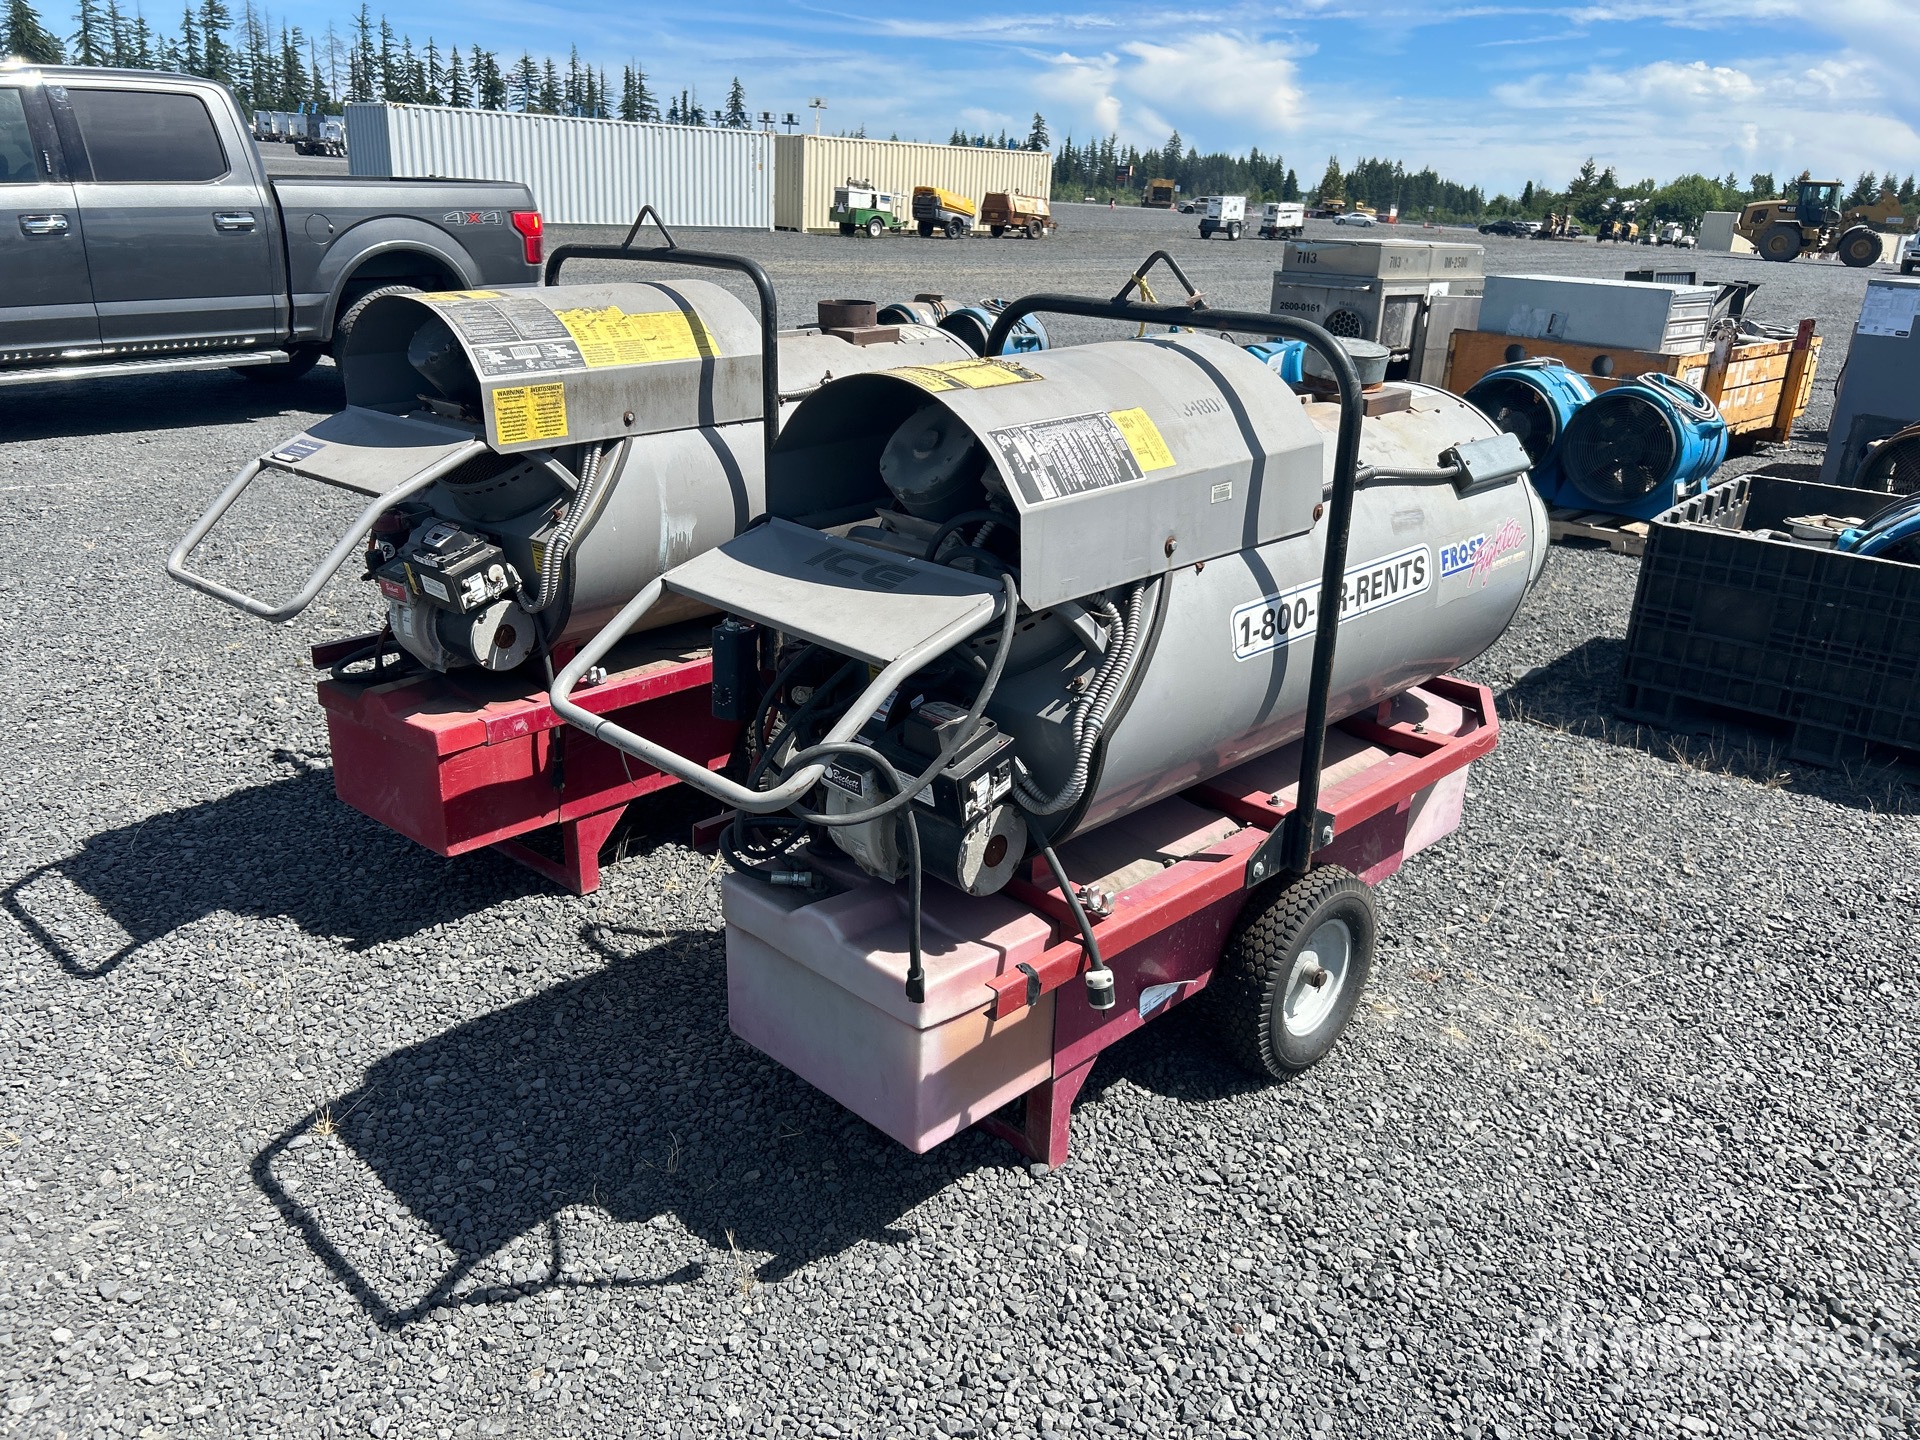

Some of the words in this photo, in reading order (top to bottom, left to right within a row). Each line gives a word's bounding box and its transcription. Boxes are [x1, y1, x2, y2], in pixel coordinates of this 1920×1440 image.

[1279, 301, 1321, 313] 2600-0161
[496, 388, 525, 397] WARNING
[803, 546, 921, 590] ICE
[1440, 536, 1484, 572] FROST
[1239, 555, 1426, 648] 1-800-R-RENTS
[832, 769, 860, 789] Beckett
